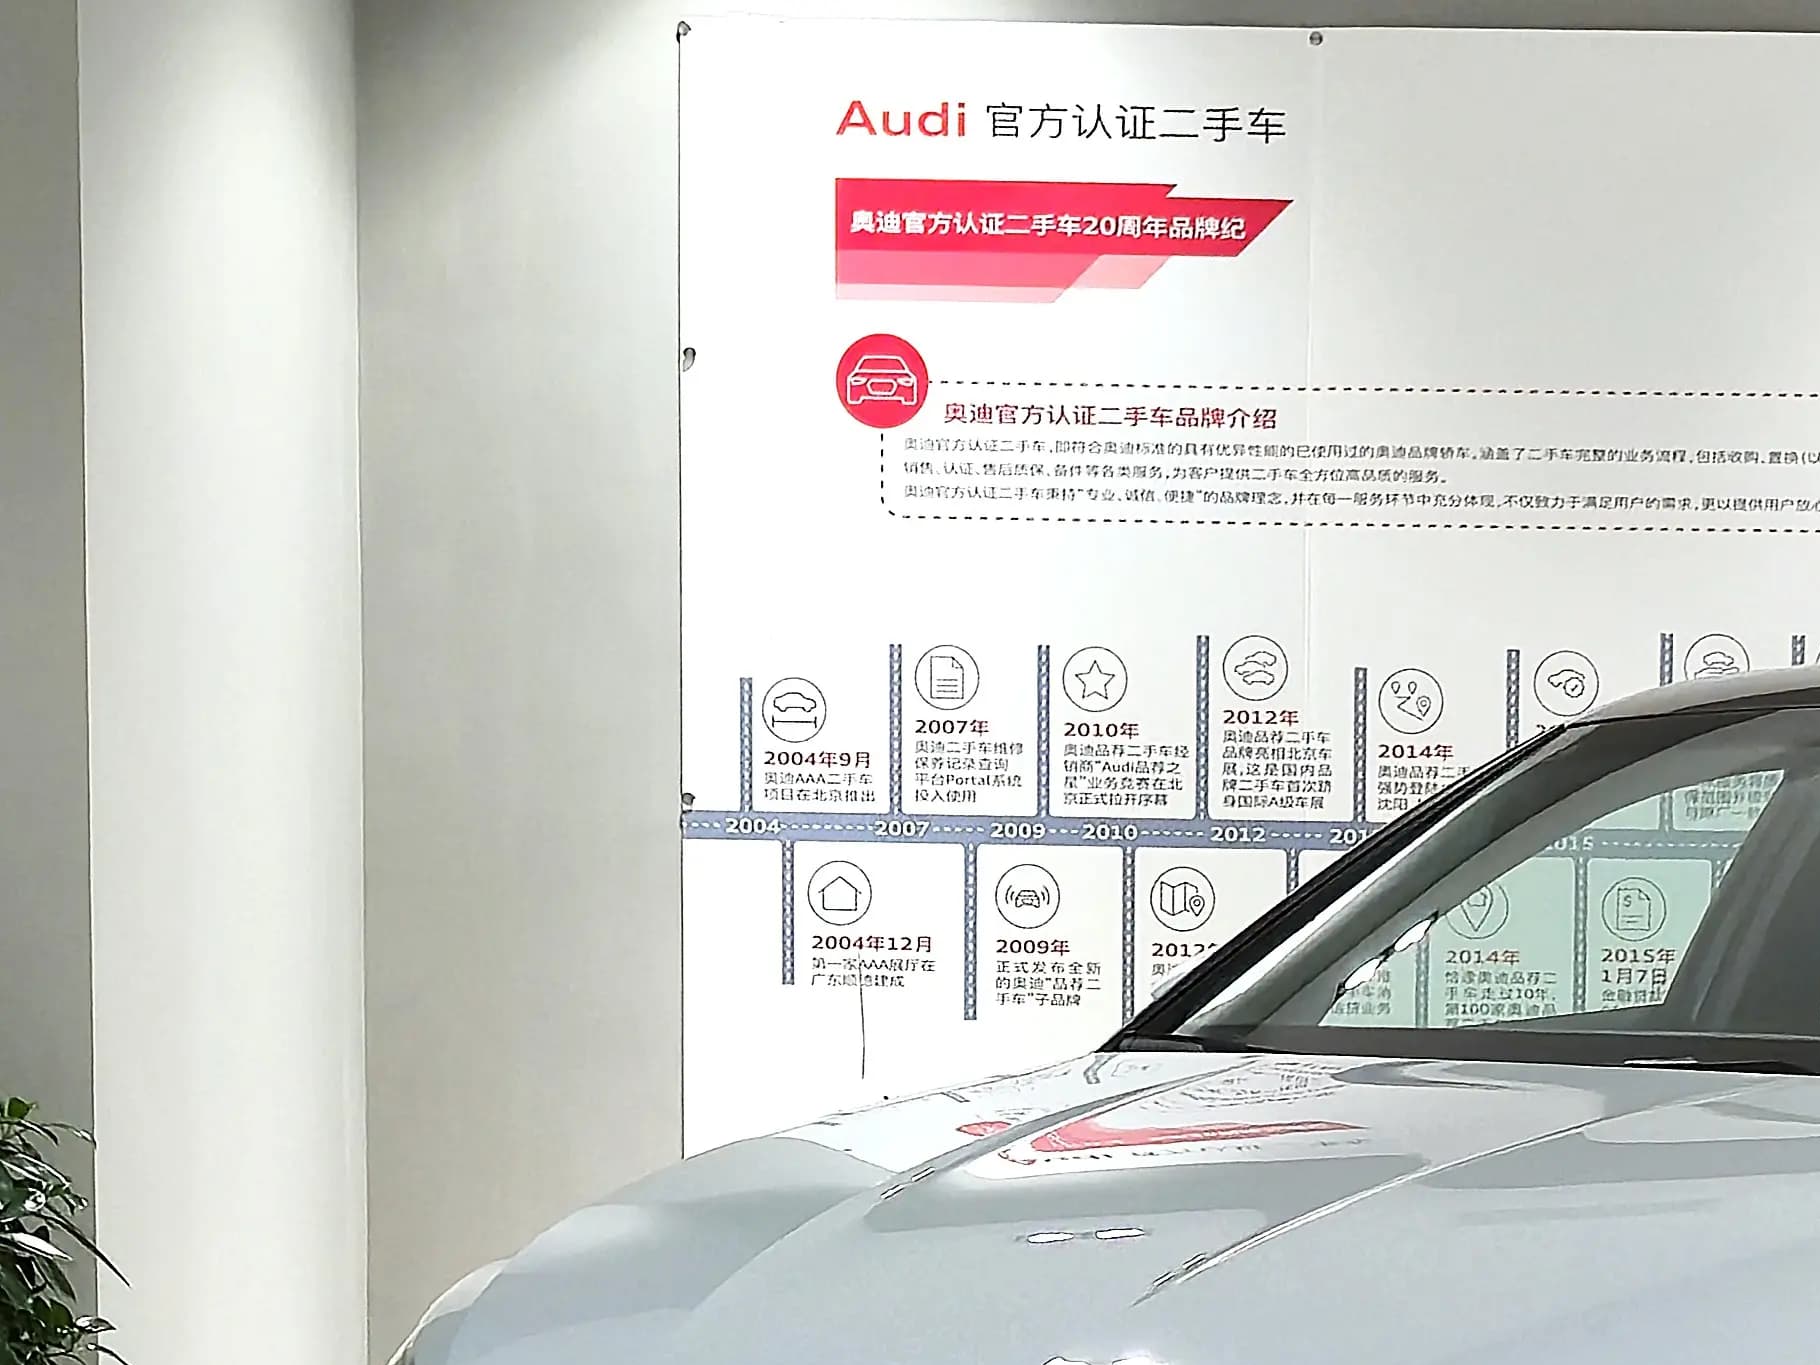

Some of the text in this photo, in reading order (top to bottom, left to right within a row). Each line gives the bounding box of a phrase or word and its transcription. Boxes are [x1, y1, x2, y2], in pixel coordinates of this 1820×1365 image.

[837, 101, 1286, 144] Audi 官方认证二手车
[849, 209, 1247, 241] 奥迪官方认证二手车20周年品牌纪
[945, 403, 1276, 429] 奥迪官方认证二手车品牌介绍
[1223, 710, 1299, 728] 2012年
[915, 720, 989, 737] 2007年
[1064, 723, 1139, 741] 2010年
[1223, 730, 1330, 744] 奥迪品荐二手车
[916, 741, 1023, 754] 奥迪二手车维修
[1064, 744, 1189, 758] 奥迪品荐二手车经
[1222, 746, 1332, 760] 品牌亮相北京车
[1378, 744, 1453, 761] 2014年
[764, 751, 869, 768] 2004年9月
[765, 772, 872, 784] 奥迪AAA二手车
[916, 773, 1022, 787] 平台Portal系统
[765, 788, 875, 802] 项目在北京推出
[916, 789, 976, 802] 投入使用
[725, 819, 1370, 846] 2004 2007 2009 2010 2012 201
[1545, 836, 1594, 851] 015
[812, 936, 931, 952] 2004年12月
[996, 940, 1070, 957] 2009年
[1151, 942, 1218, 957] 2012
[1446, 950, 1520, 967] 2014年
[1601, 948, 1677, 965] 2015年
[997, 961, 1100, 974] 正式发布全新
[1601, 967, 1668, 986] 1月7日
